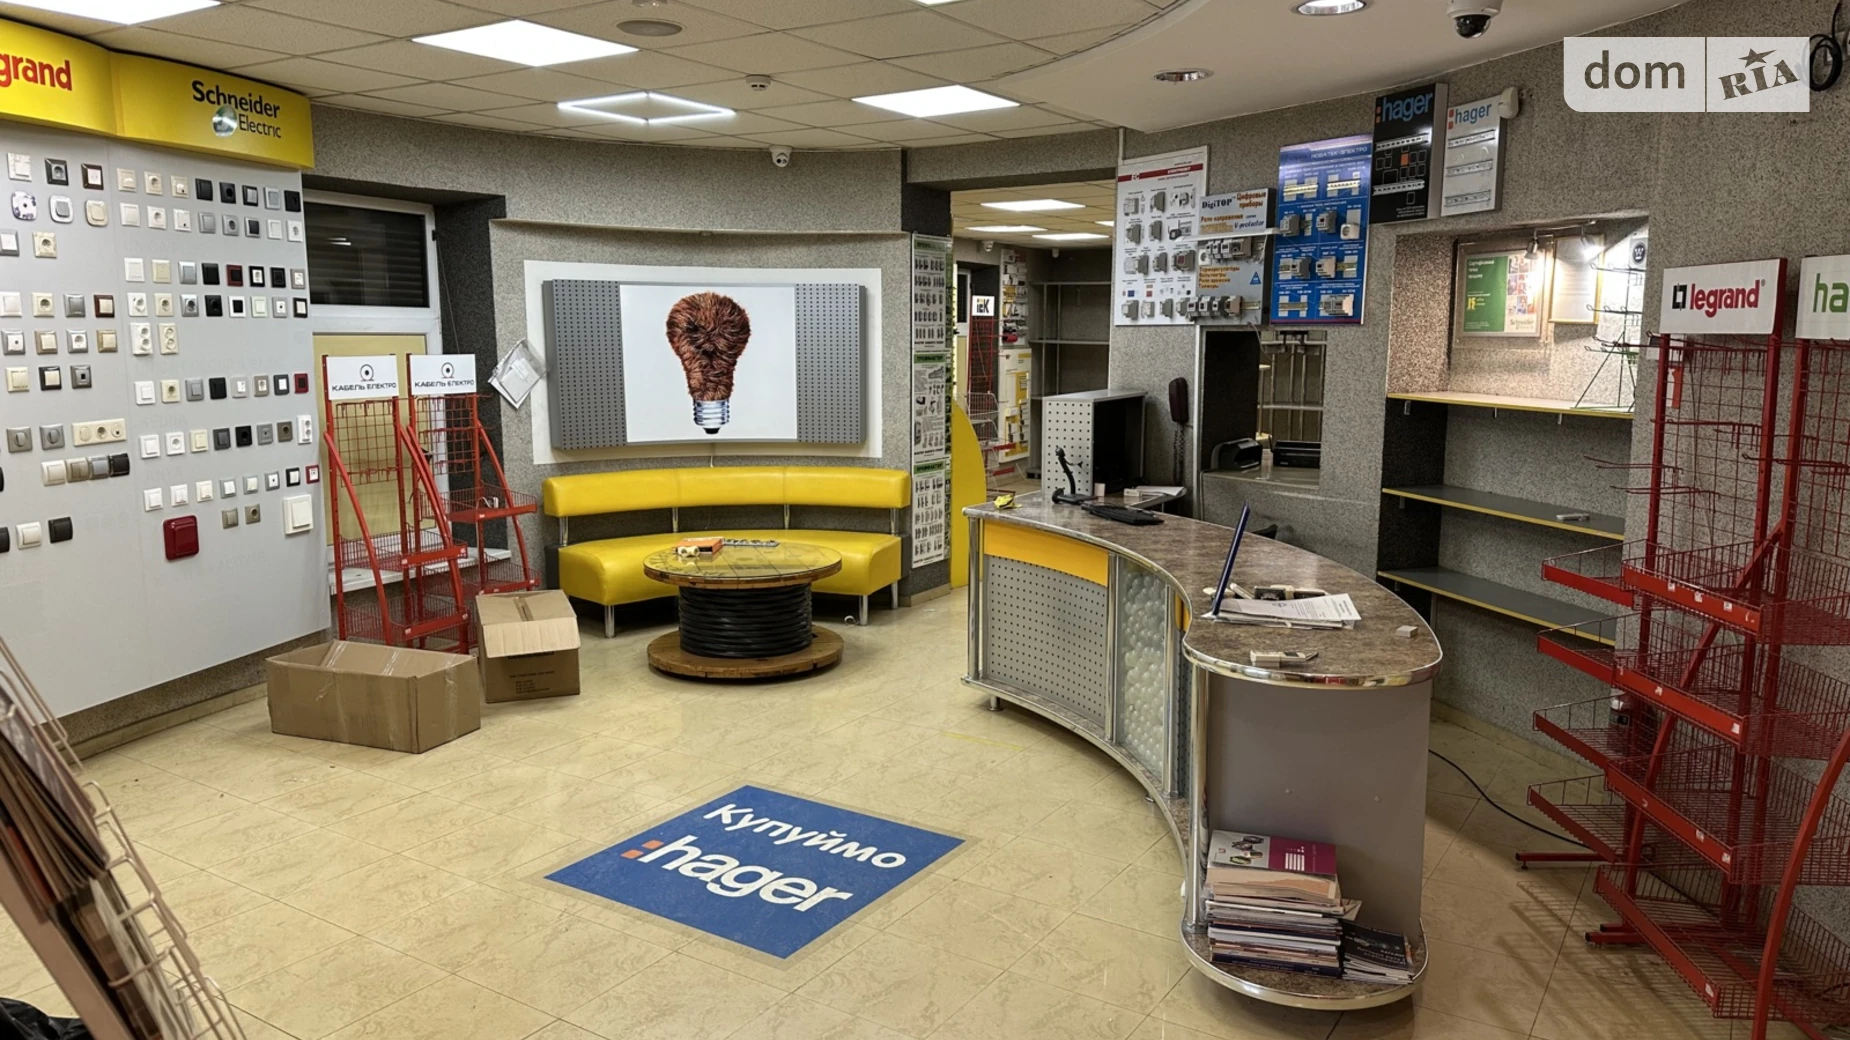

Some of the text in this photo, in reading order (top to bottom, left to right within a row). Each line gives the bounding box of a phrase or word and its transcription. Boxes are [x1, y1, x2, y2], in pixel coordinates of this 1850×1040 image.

[191, 79, 281, 119] Schneider
[1382, 91, 1434, 123] hager
[1454, 102, 1493, 126] hager
[238, 113, 282, 139] Electric
[1201, 199, 1232, 209] DigiTOP
[1689, 279, 1761, 318] legrand
[1812, 272, 1850, 313] ha
[331, 382, 397, 392] КАБЕЛЬ ЕЛЕКТРО
[414, 379, 475, 389] КАБЕЛЬ ЕЛЕКТРО
[703, 803, 907, 869] Купуймо
[637, 835, 854, 913] hager
